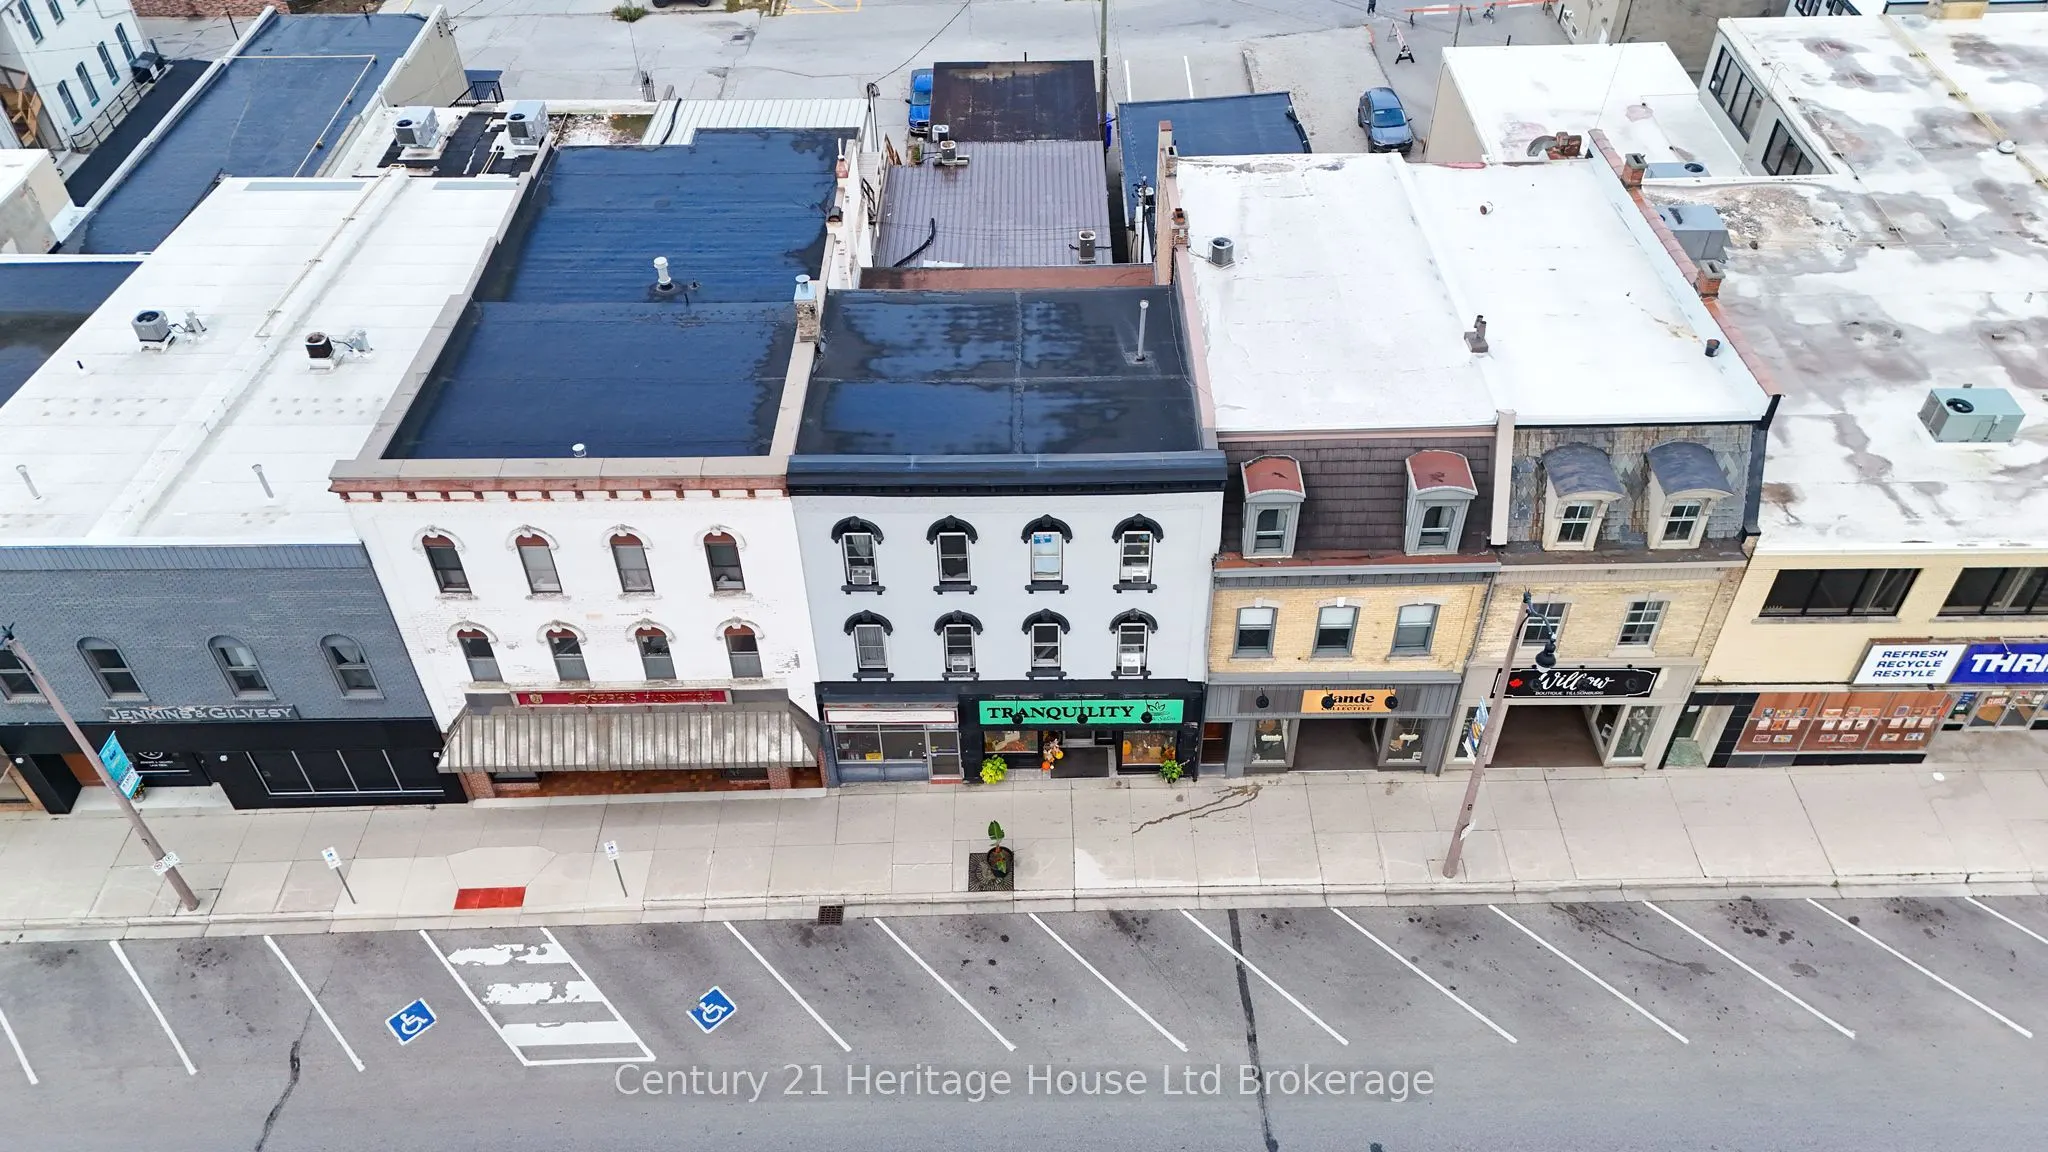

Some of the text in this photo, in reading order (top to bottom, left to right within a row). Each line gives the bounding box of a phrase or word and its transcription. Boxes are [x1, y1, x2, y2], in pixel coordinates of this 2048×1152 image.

[1882, 650, 1948, 658] REFRESH
[1876, 660, 1943, 668] RECYCLE
[1970, 653, 2048, 673] THRI
[108, 707, 292, 721] JENKINS & GILVESY
[987, 705, 1135, 721] TRANQUILITY
